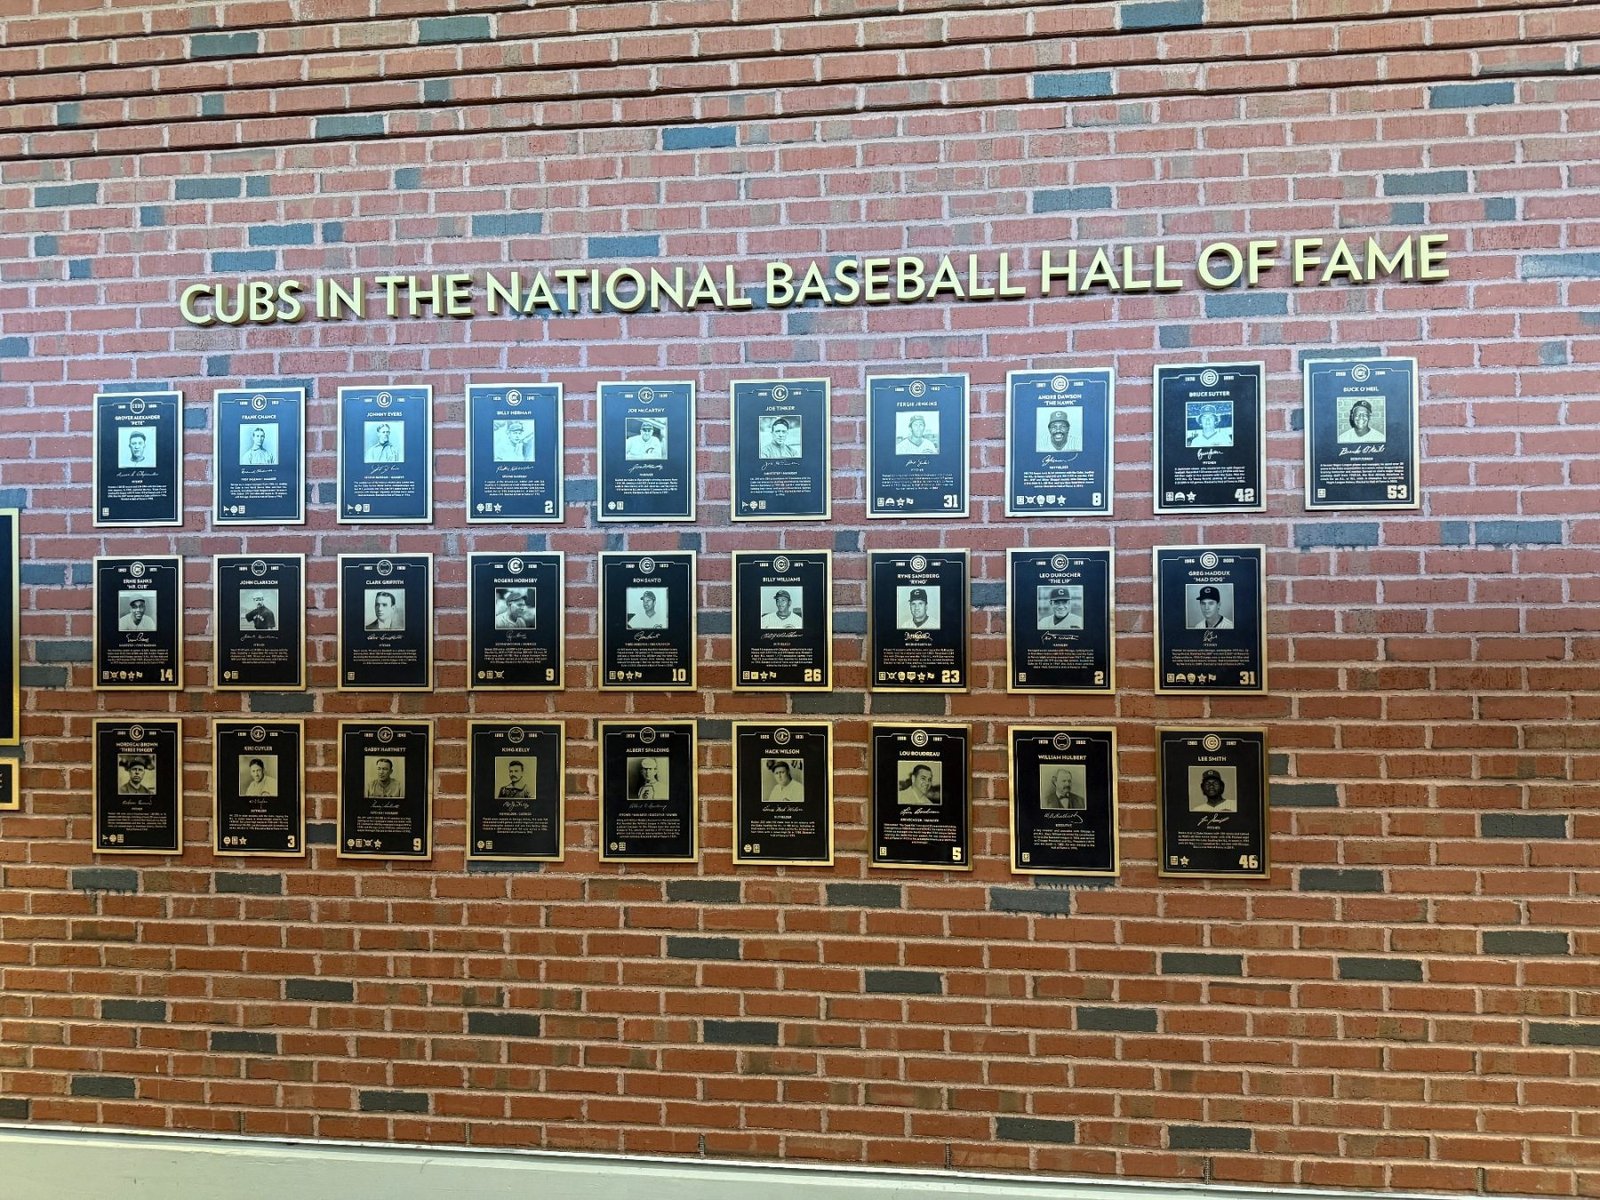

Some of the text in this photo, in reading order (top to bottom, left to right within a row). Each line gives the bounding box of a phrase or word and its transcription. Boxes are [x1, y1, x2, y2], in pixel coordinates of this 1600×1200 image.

[179, 233, 1450, 325] CUBS IN THE NATIONAL BASEBALL HALL OF FAME
[1235, 488, 1254, 502] 42
[1387, 485, 1407, 499] 53
[944, 494, 958, 508] 31
[1092, 492, 1101, 506] 8
[545, 500, 553, 513] 2
[160, 669, 173, 681] 14
[546, 668, 554, 681] 9
[672, 669, 686, 682] 10
[804, 669, 821, 682] 26
[942, 670, 960, 683] 23
[1095, 671, 1104, 684] 2
[1240, 671, 1255, 684] 31
[288, 836, 295, 847] 3
[413, 838, 421, 851] 9
[952, 846, 961, 860] 5
[1239, 855, 1258, 868] 46
